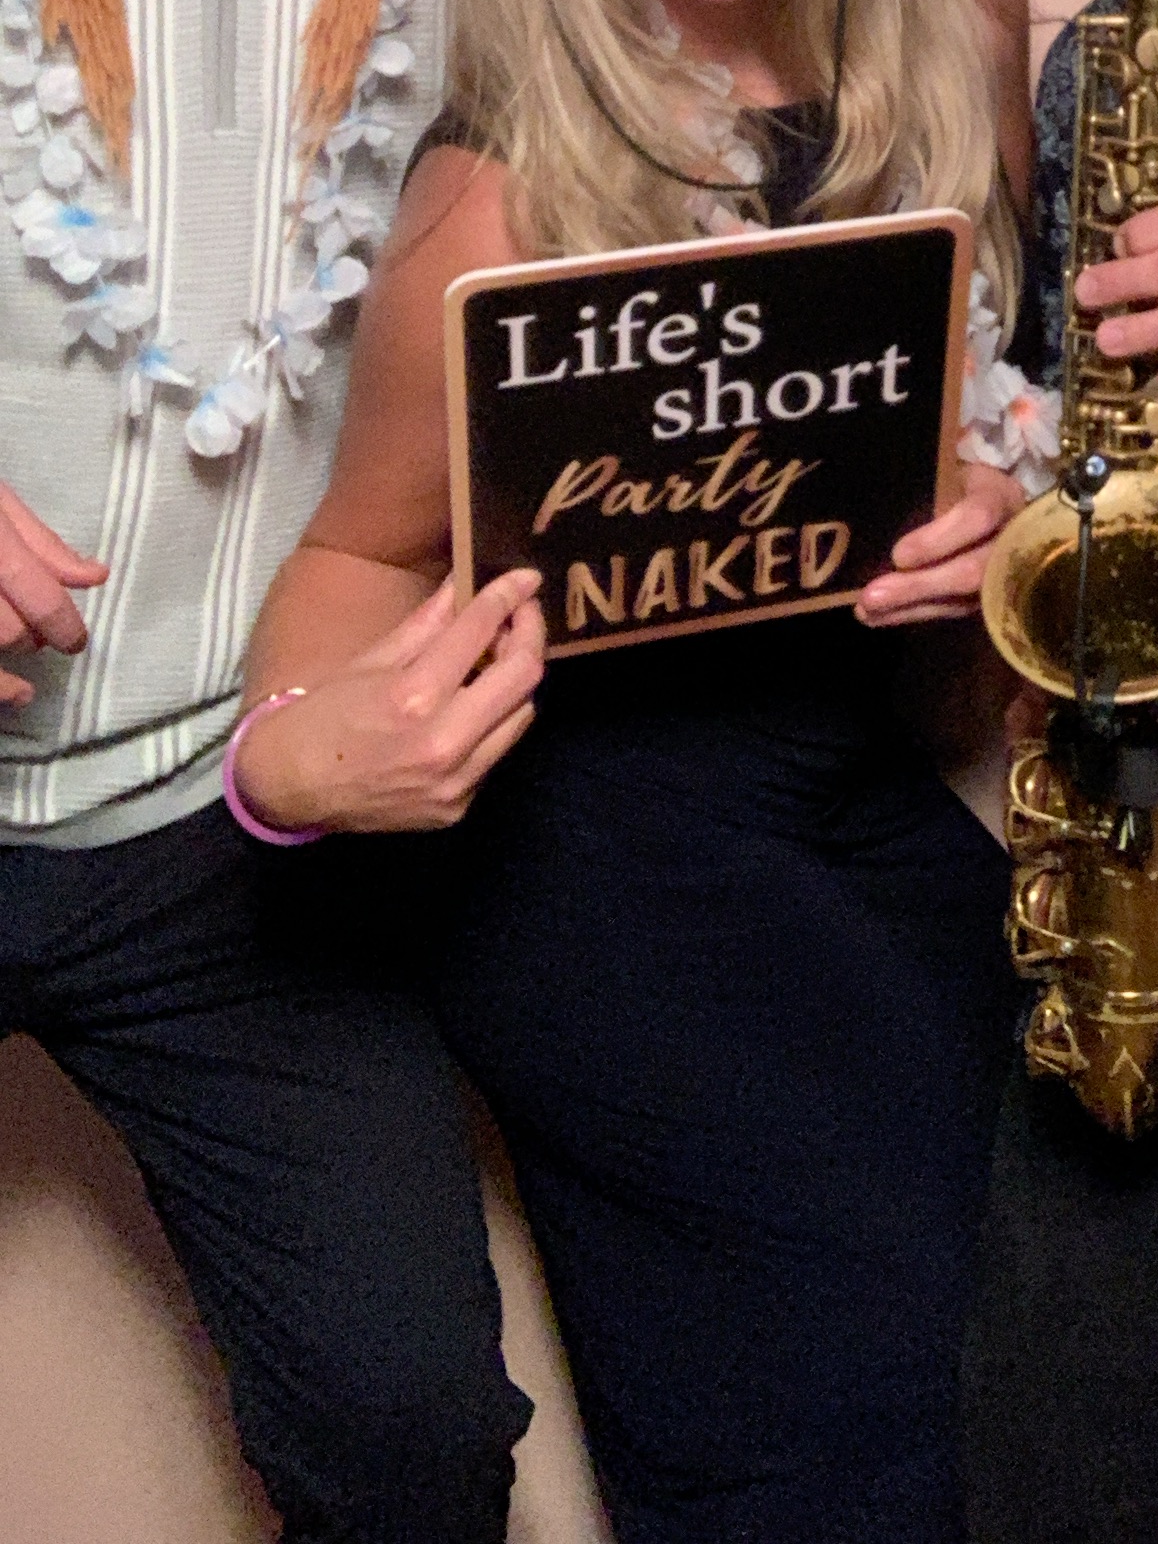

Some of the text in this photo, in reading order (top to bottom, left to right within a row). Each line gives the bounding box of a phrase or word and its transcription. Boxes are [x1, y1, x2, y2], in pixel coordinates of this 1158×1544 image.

[496, 282, 763, 390] Life's
[651, 343, 911, 440] short
[533, 431, 822, 535] Party
[565, 521, 852, 631] NAKED
